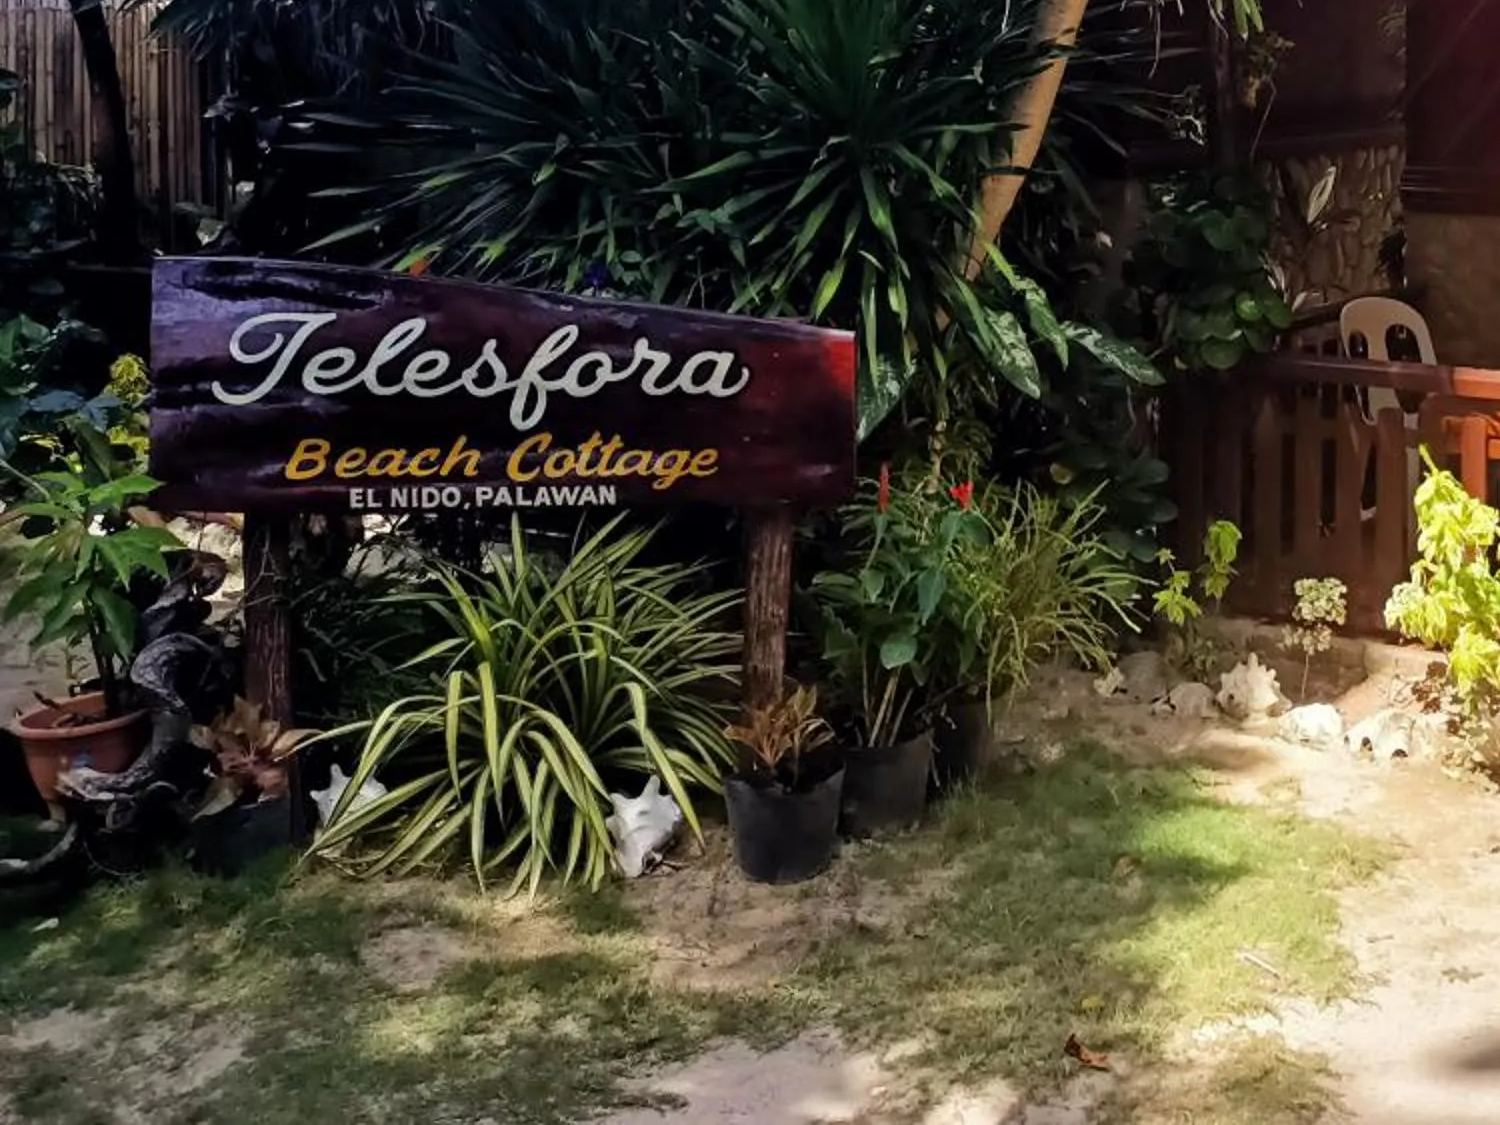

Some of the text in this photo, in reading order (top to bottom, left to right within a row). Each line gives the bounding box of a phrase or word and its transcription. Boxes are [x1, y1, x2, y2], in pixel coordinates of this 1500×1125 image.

[211, 312, 750, 431] Telesfora
[284, 430, 719, 490] Beach Cottage
[349, 487, 383, 509] EL
[475, 485, 617, 507] PALAWAN
